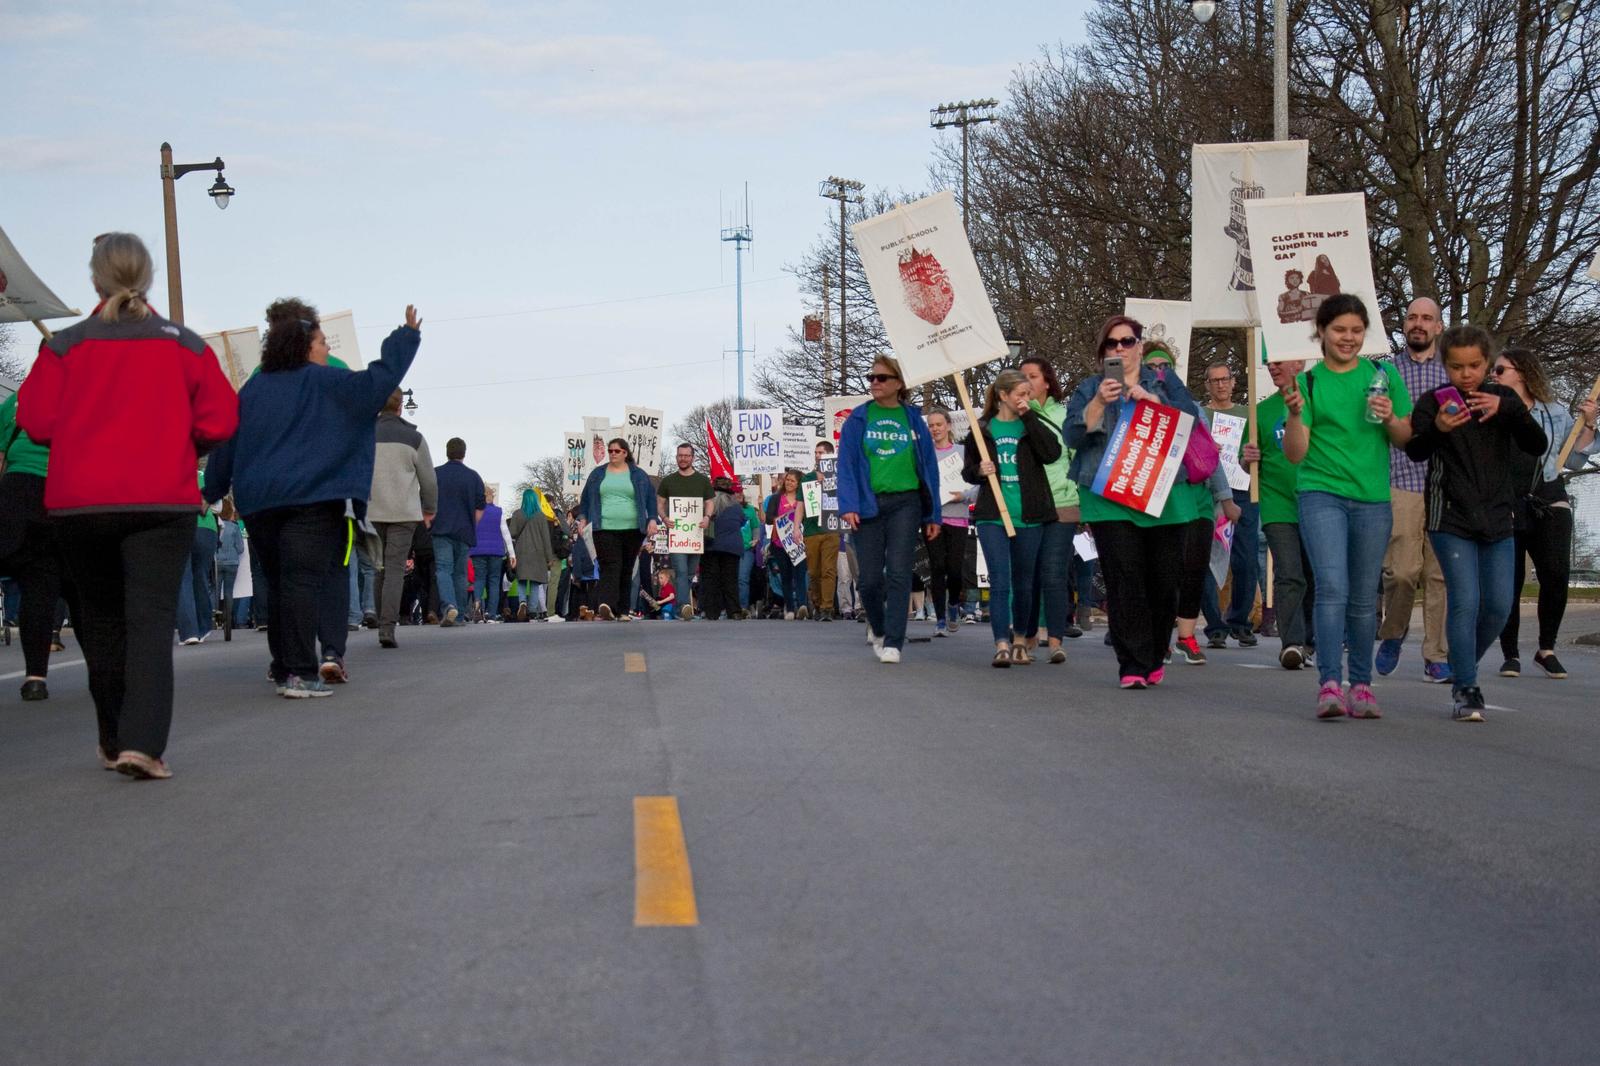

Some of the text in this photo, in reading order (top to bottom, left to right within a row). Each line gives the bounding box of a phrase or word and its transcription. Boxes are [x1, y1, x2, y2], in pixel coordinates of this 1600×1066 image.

[880, 225, 939, 251] PUBLIC SCHOOLS
[1271, 230, 1349, 243] CLOSE THE MPS
[1273, 240, 1318, 252] FUNDING
[1274, 252, 1296, 261] GAP
[916, 325, 973, 351] OF THE COMMUNITY
[927, 324, 959, 340] THE HEART
[628, 413, 659, 429] SAVE
[738, 413, 772, 432] FUND
[567, 438, 586, 450] SAV
[736, 431, 775, 443] OUR
[866, 430, 908, 442] mtea
[734, 441, 780, 459] FUTURE!
[998, 451, 1017, 464] te
[1111, 405, 1154, 494] The schools all our
[1131, 452, 1154, 497] children
[1150, 412, 1171, 458] deserve!
[1105, 455, 1114, 467] WE
[673, 499, 699, 518] Fight
[674, 518, 696, 532] For
[670, 534, 701, 551] Funding
